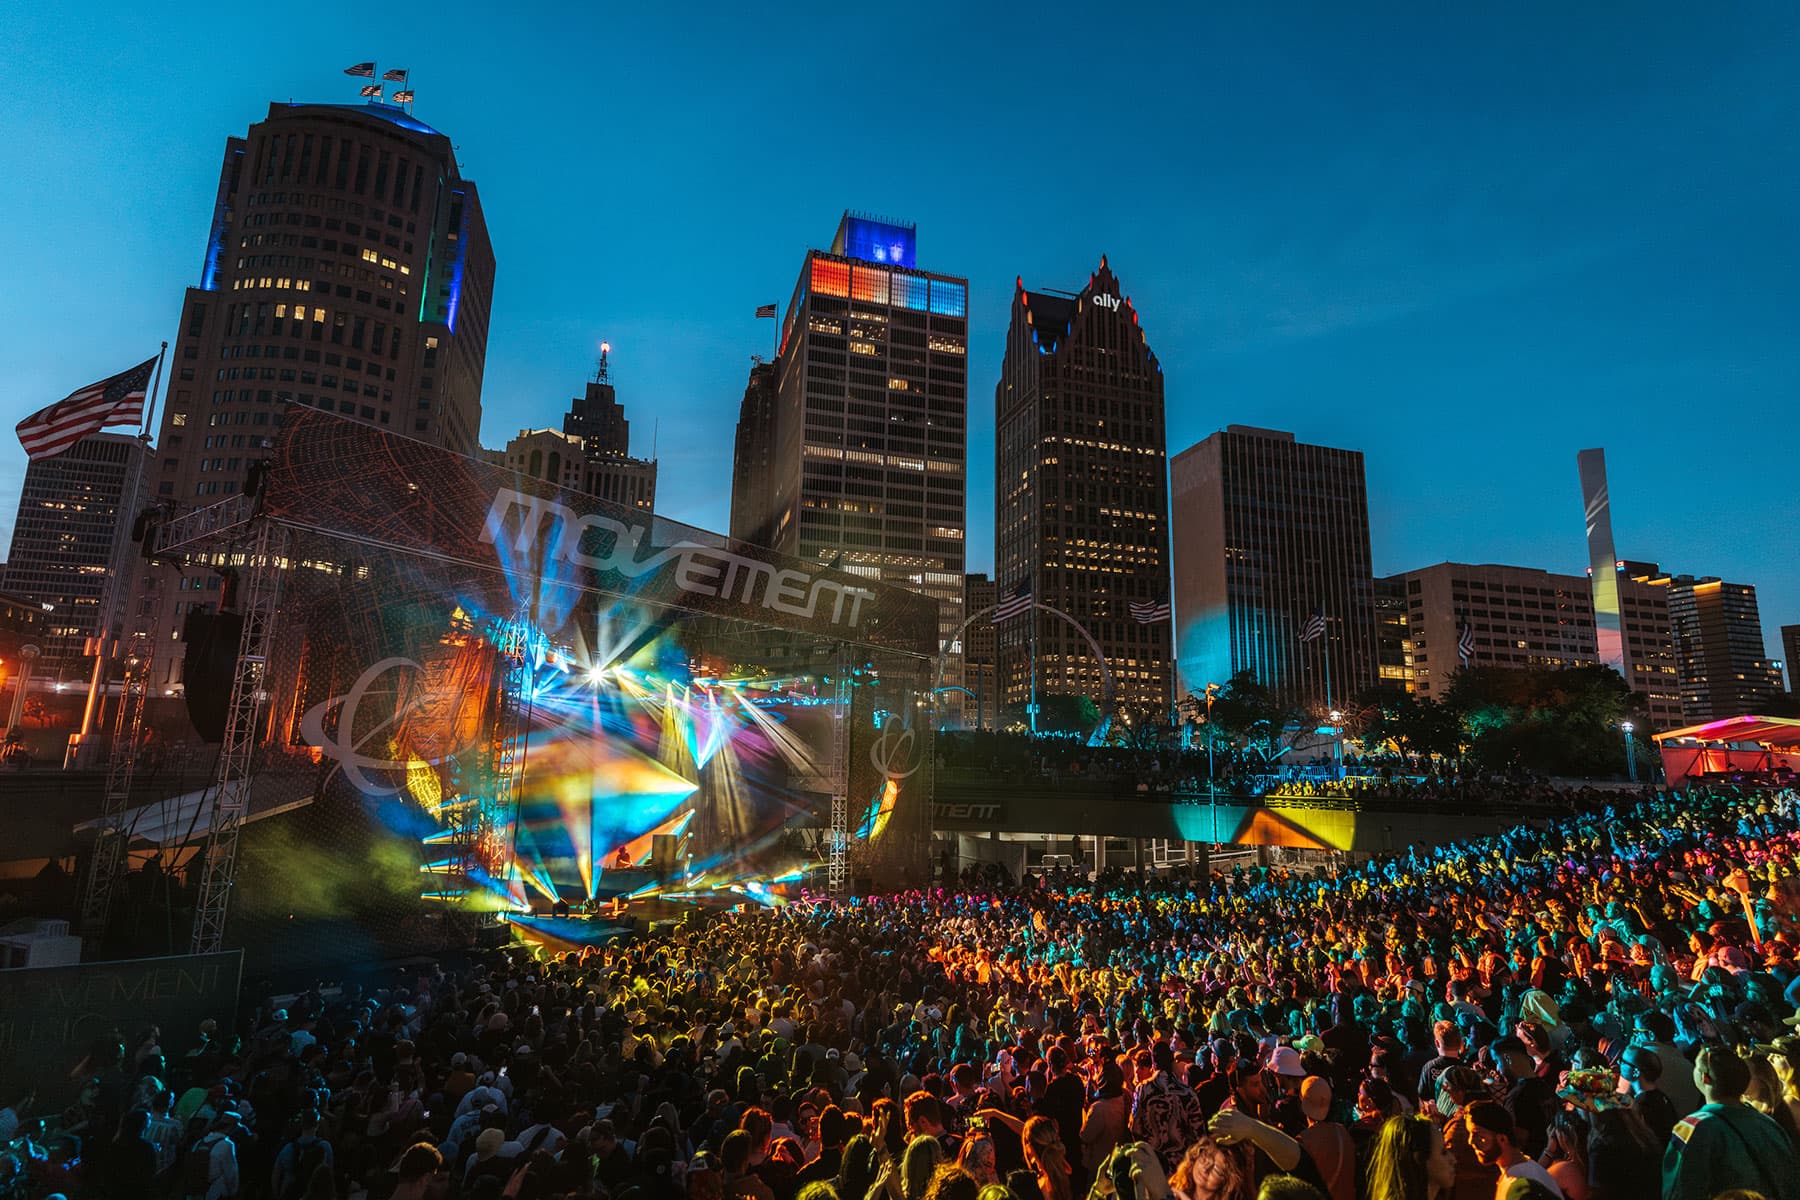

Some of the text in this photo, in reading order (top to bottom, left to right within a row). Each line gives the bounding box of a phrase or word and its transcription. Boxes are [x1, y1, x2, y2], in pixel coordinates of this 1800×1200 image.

[895, 264, 928, 278] BANK
[1092, 292, 1120, 312] ally
[478, 487, 875, 627] MOVEMENT
